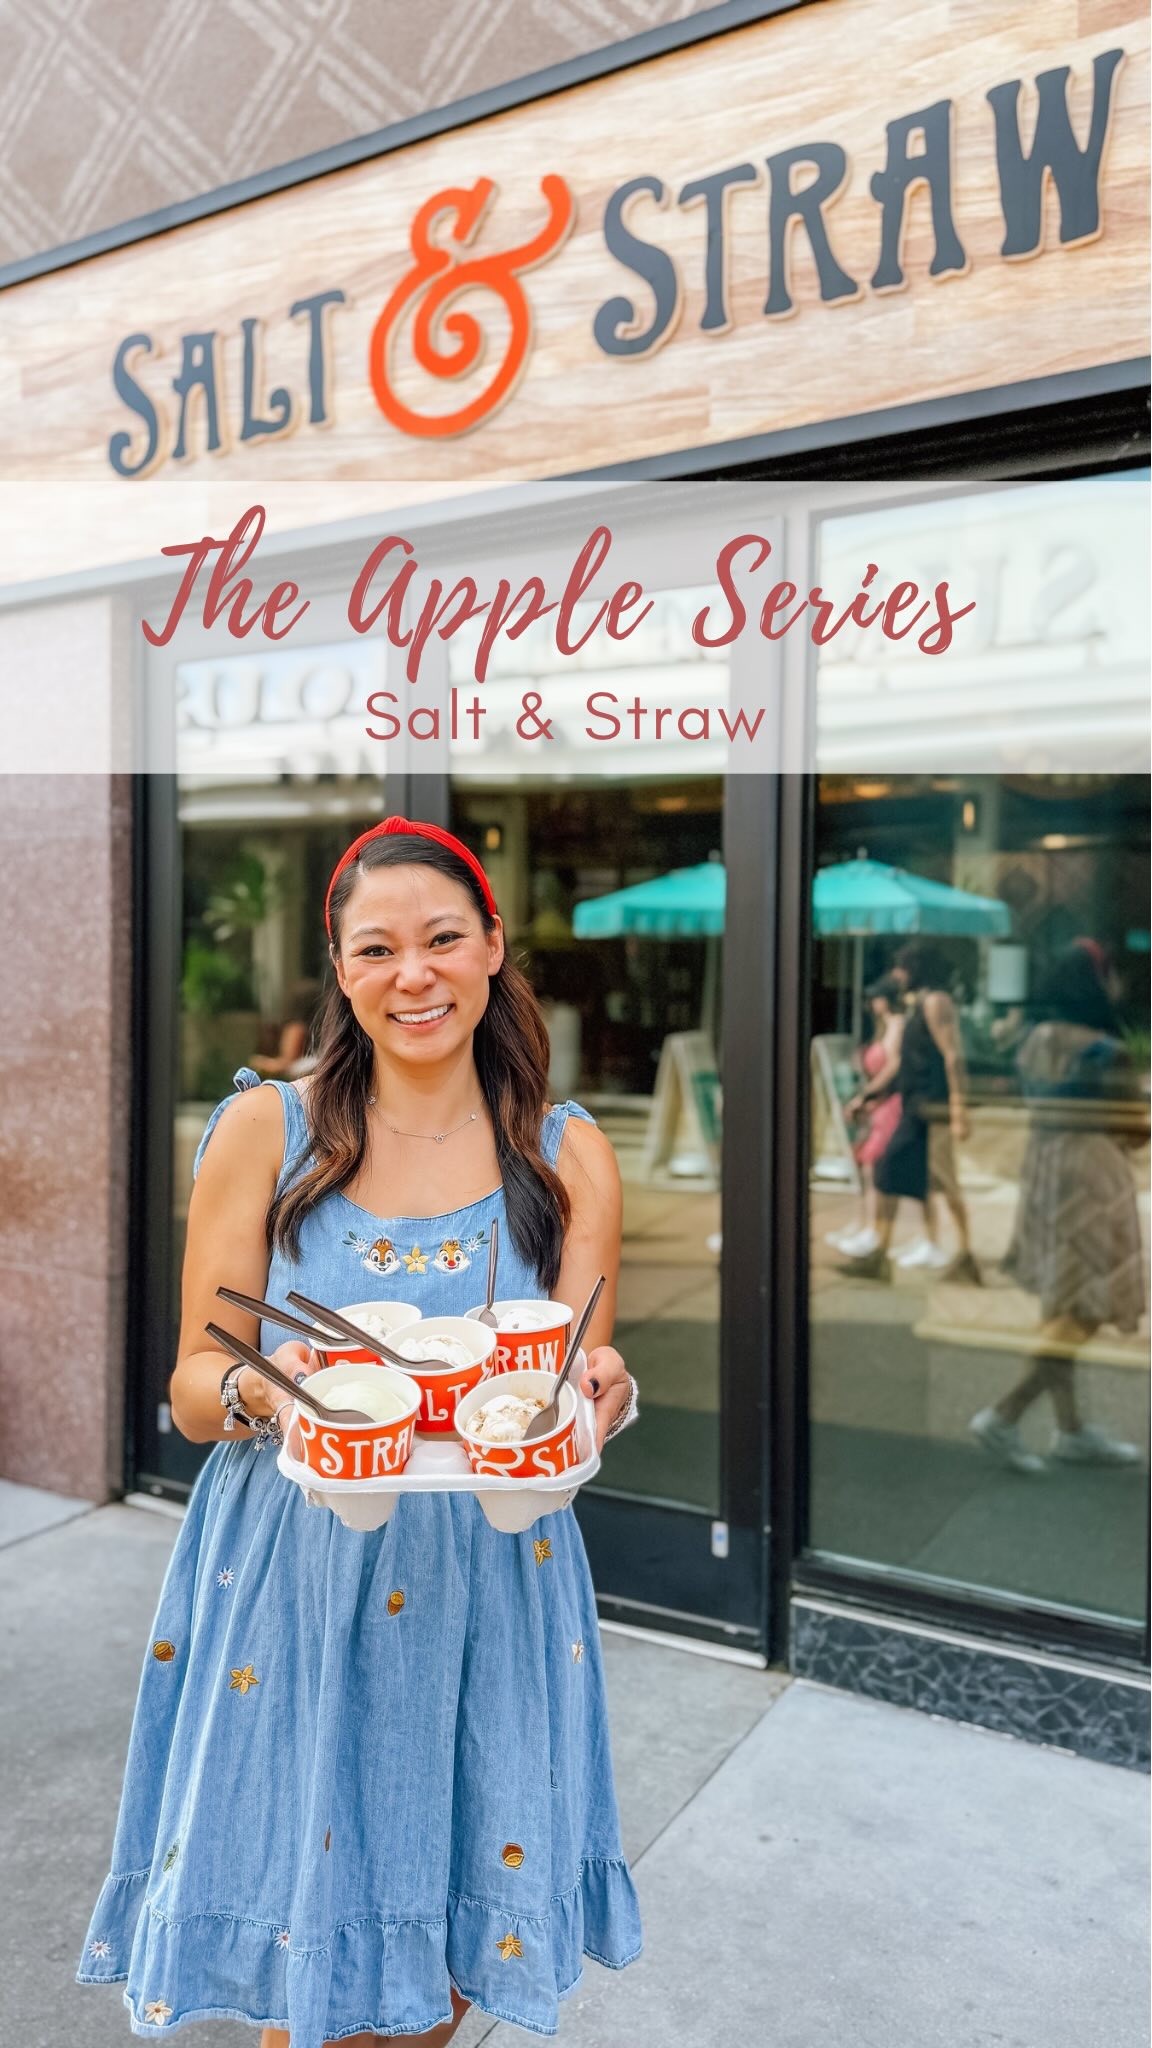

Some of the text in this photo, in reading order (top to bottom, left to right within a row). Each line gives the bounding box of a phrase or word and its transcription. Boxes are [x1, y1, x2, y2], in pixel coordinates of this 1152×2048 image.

[110, 48, 1125, 477] SALT & STRAW
[494, 1340, 560, 1374] RAW
[416, 1383, 468, 1421] LT
[319, 1418, 416, 1477] STRA
